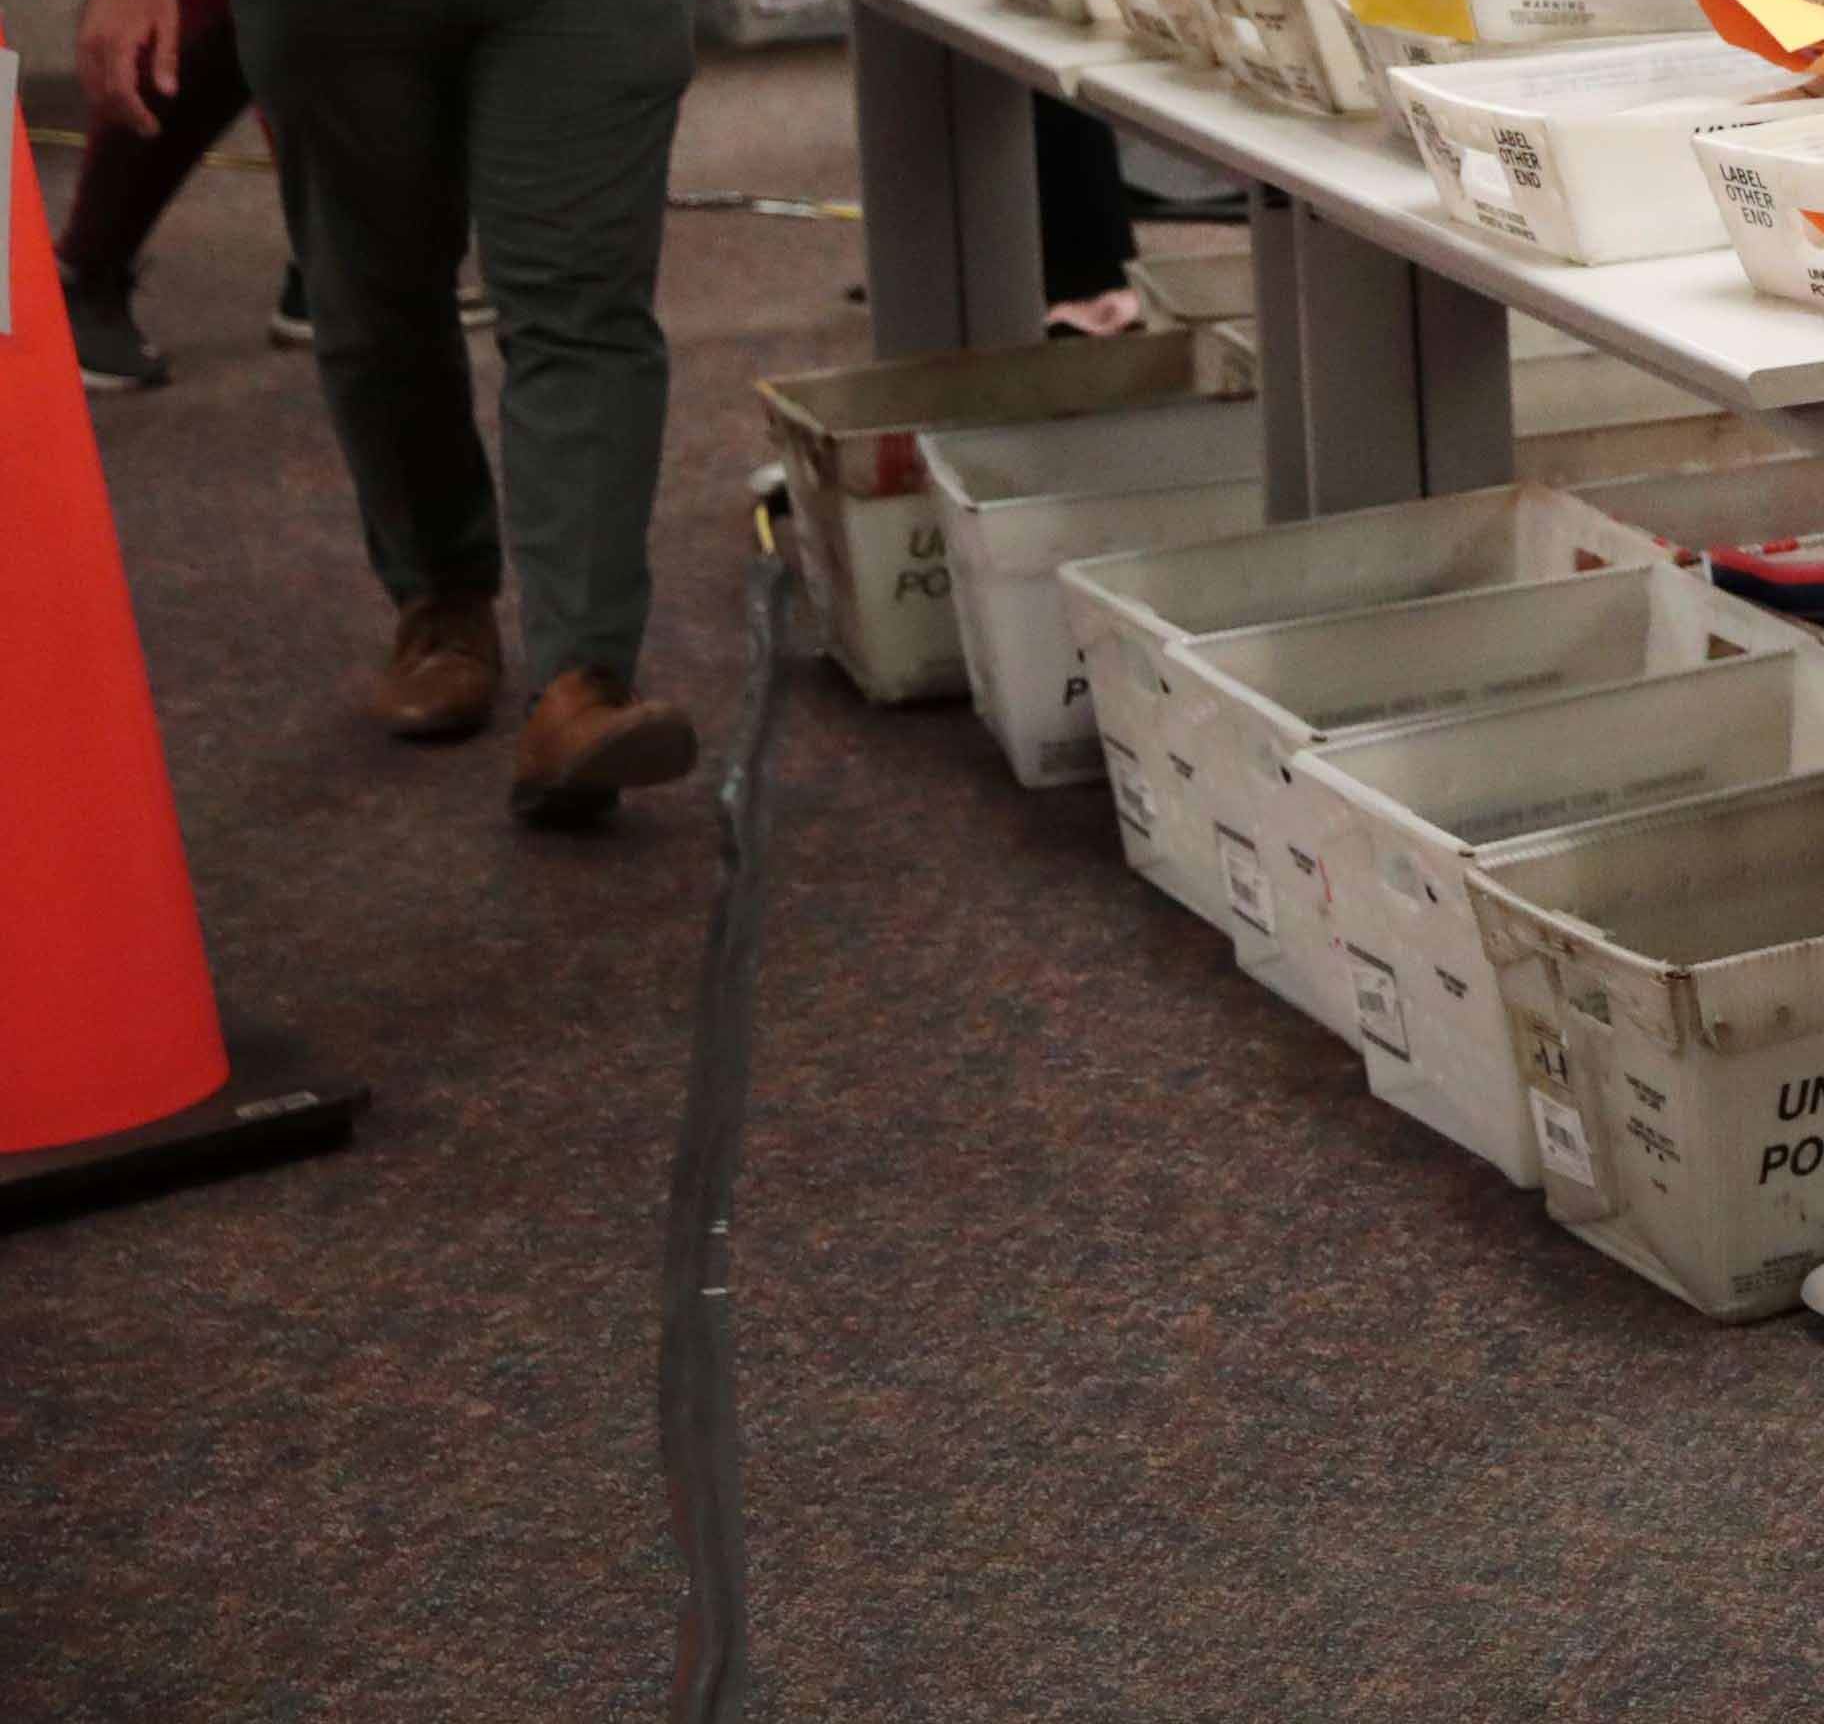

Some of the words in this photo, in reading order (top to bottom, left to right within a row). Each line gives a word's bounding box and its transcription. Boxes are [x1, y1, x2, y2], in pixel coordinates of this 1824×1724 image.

[1522, 0, 1586, 11] WARNING
[1492, 127, 1534, 151] LABEL
[1499, 147, 1542, 172] OTHER
[1513, 168, 1542, 189] END
[1719, 162, 1768, 190] LABEL
[1726, 184, 1776, 212] OTHER
[1741, 206, 1774, 229] END
